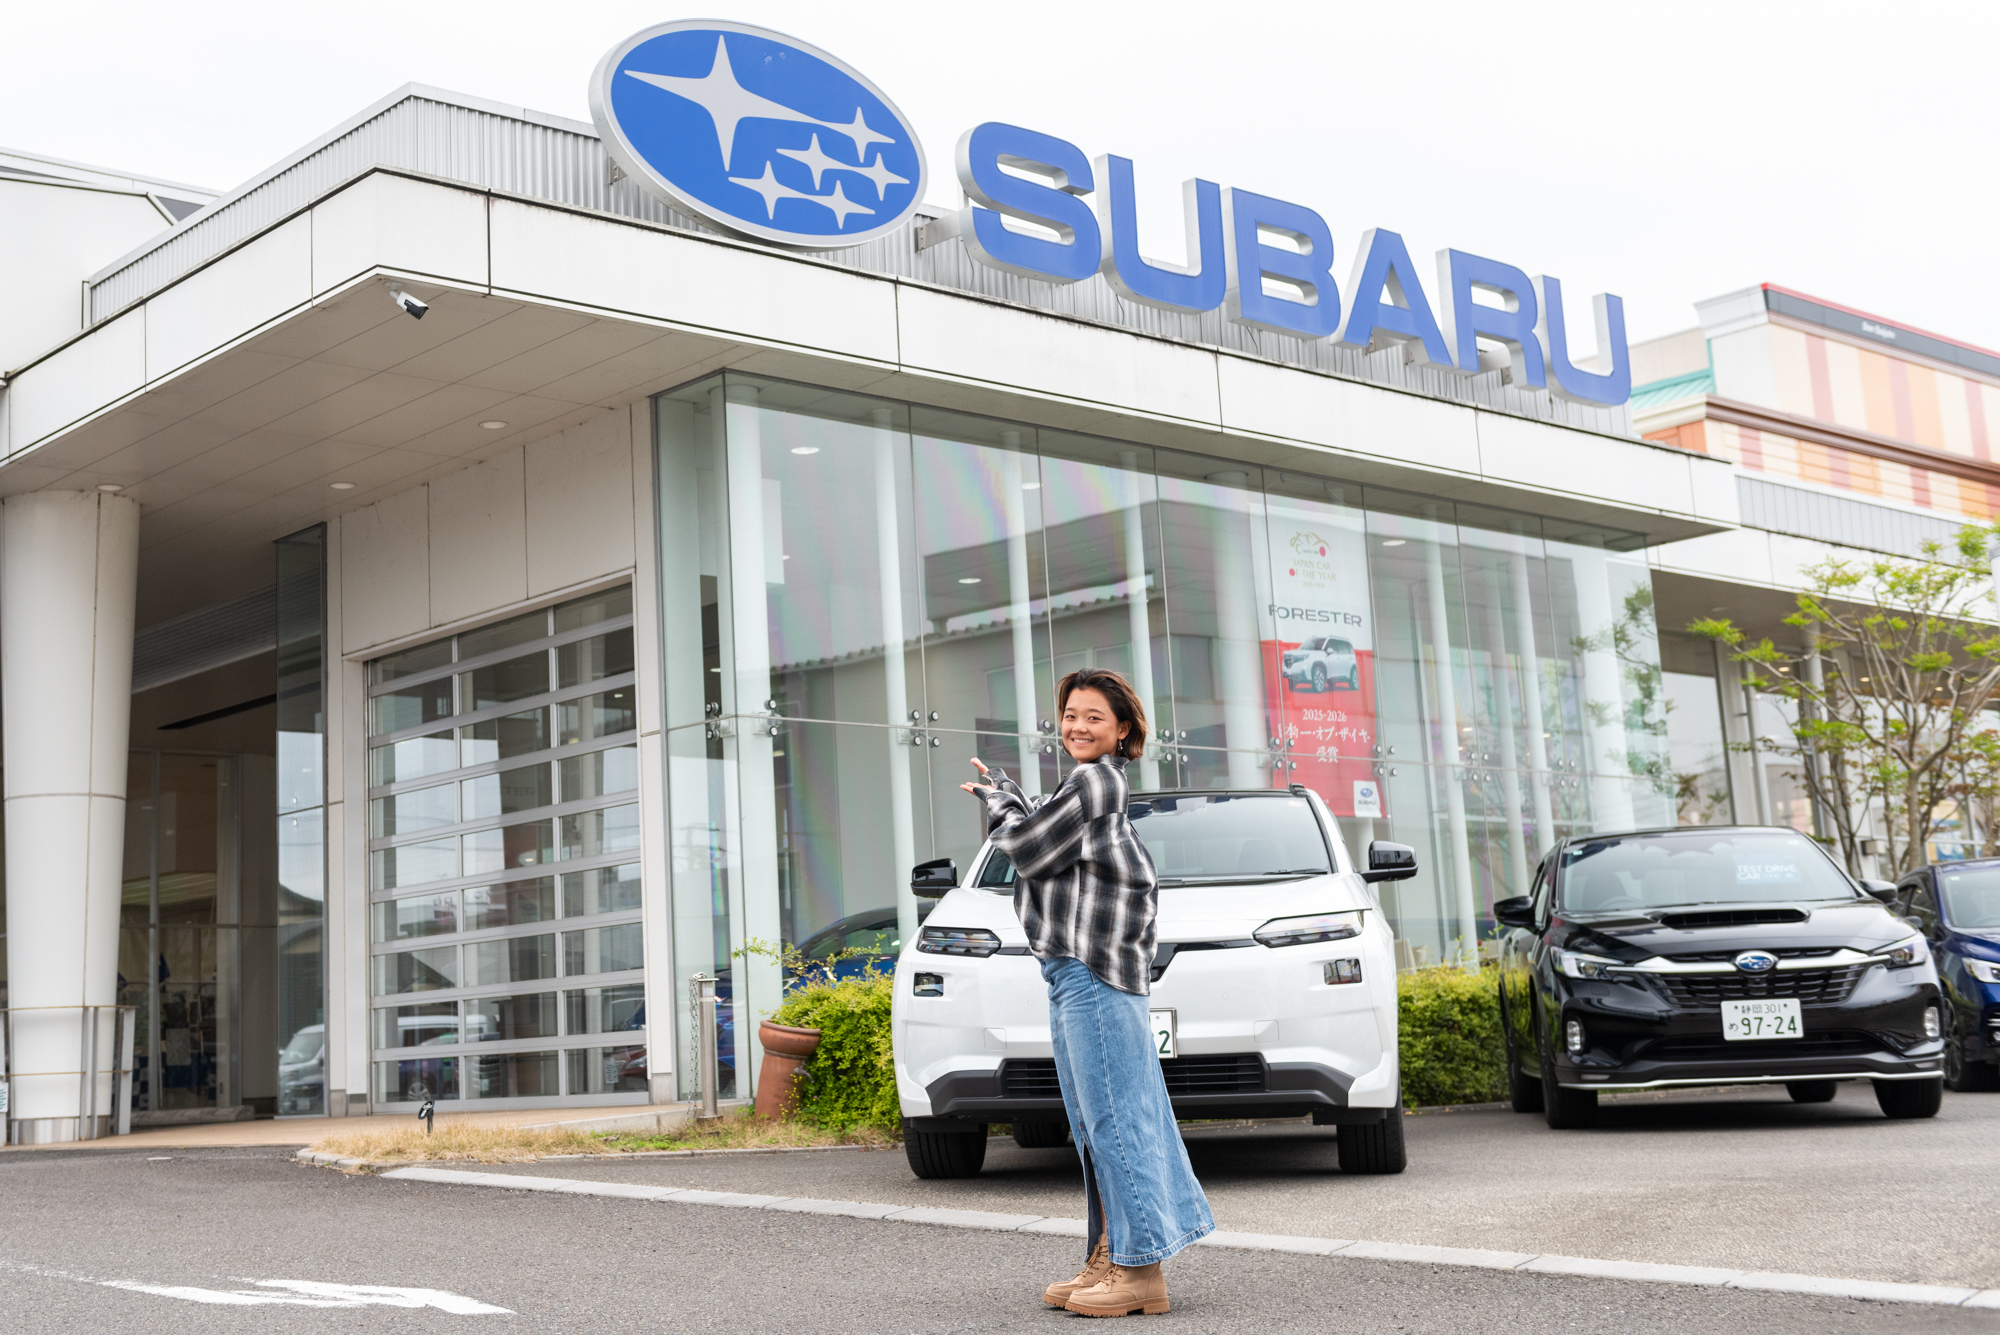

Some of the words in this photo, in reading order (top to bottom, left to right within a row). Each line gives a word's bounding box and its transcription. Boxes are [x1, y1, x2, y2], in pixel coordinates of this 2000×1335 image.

[955, 121, 1631, 408] SUBARU
[1293, 558, 1315, 569] JAPAN
[1316, 561, 1331, 571] CAR
[1302, 569, 1316, 580] THE
[1318, 571, 1337, 582] YEAR
[1268, 604, 1362, 627] FORESTER
[1302, 708, 1347, 722] 2025-2026
[1316, 745, 1339, 763] 受賞
[1737, 864, 1762, 873] TEST
[1765, 864, 1797, 873] DRIVE
[1737, 872, 1761, 881] CAR
[1728, 1022, 1739, 1032] め
[1741, 1015, 1797, 1036] 97-24
